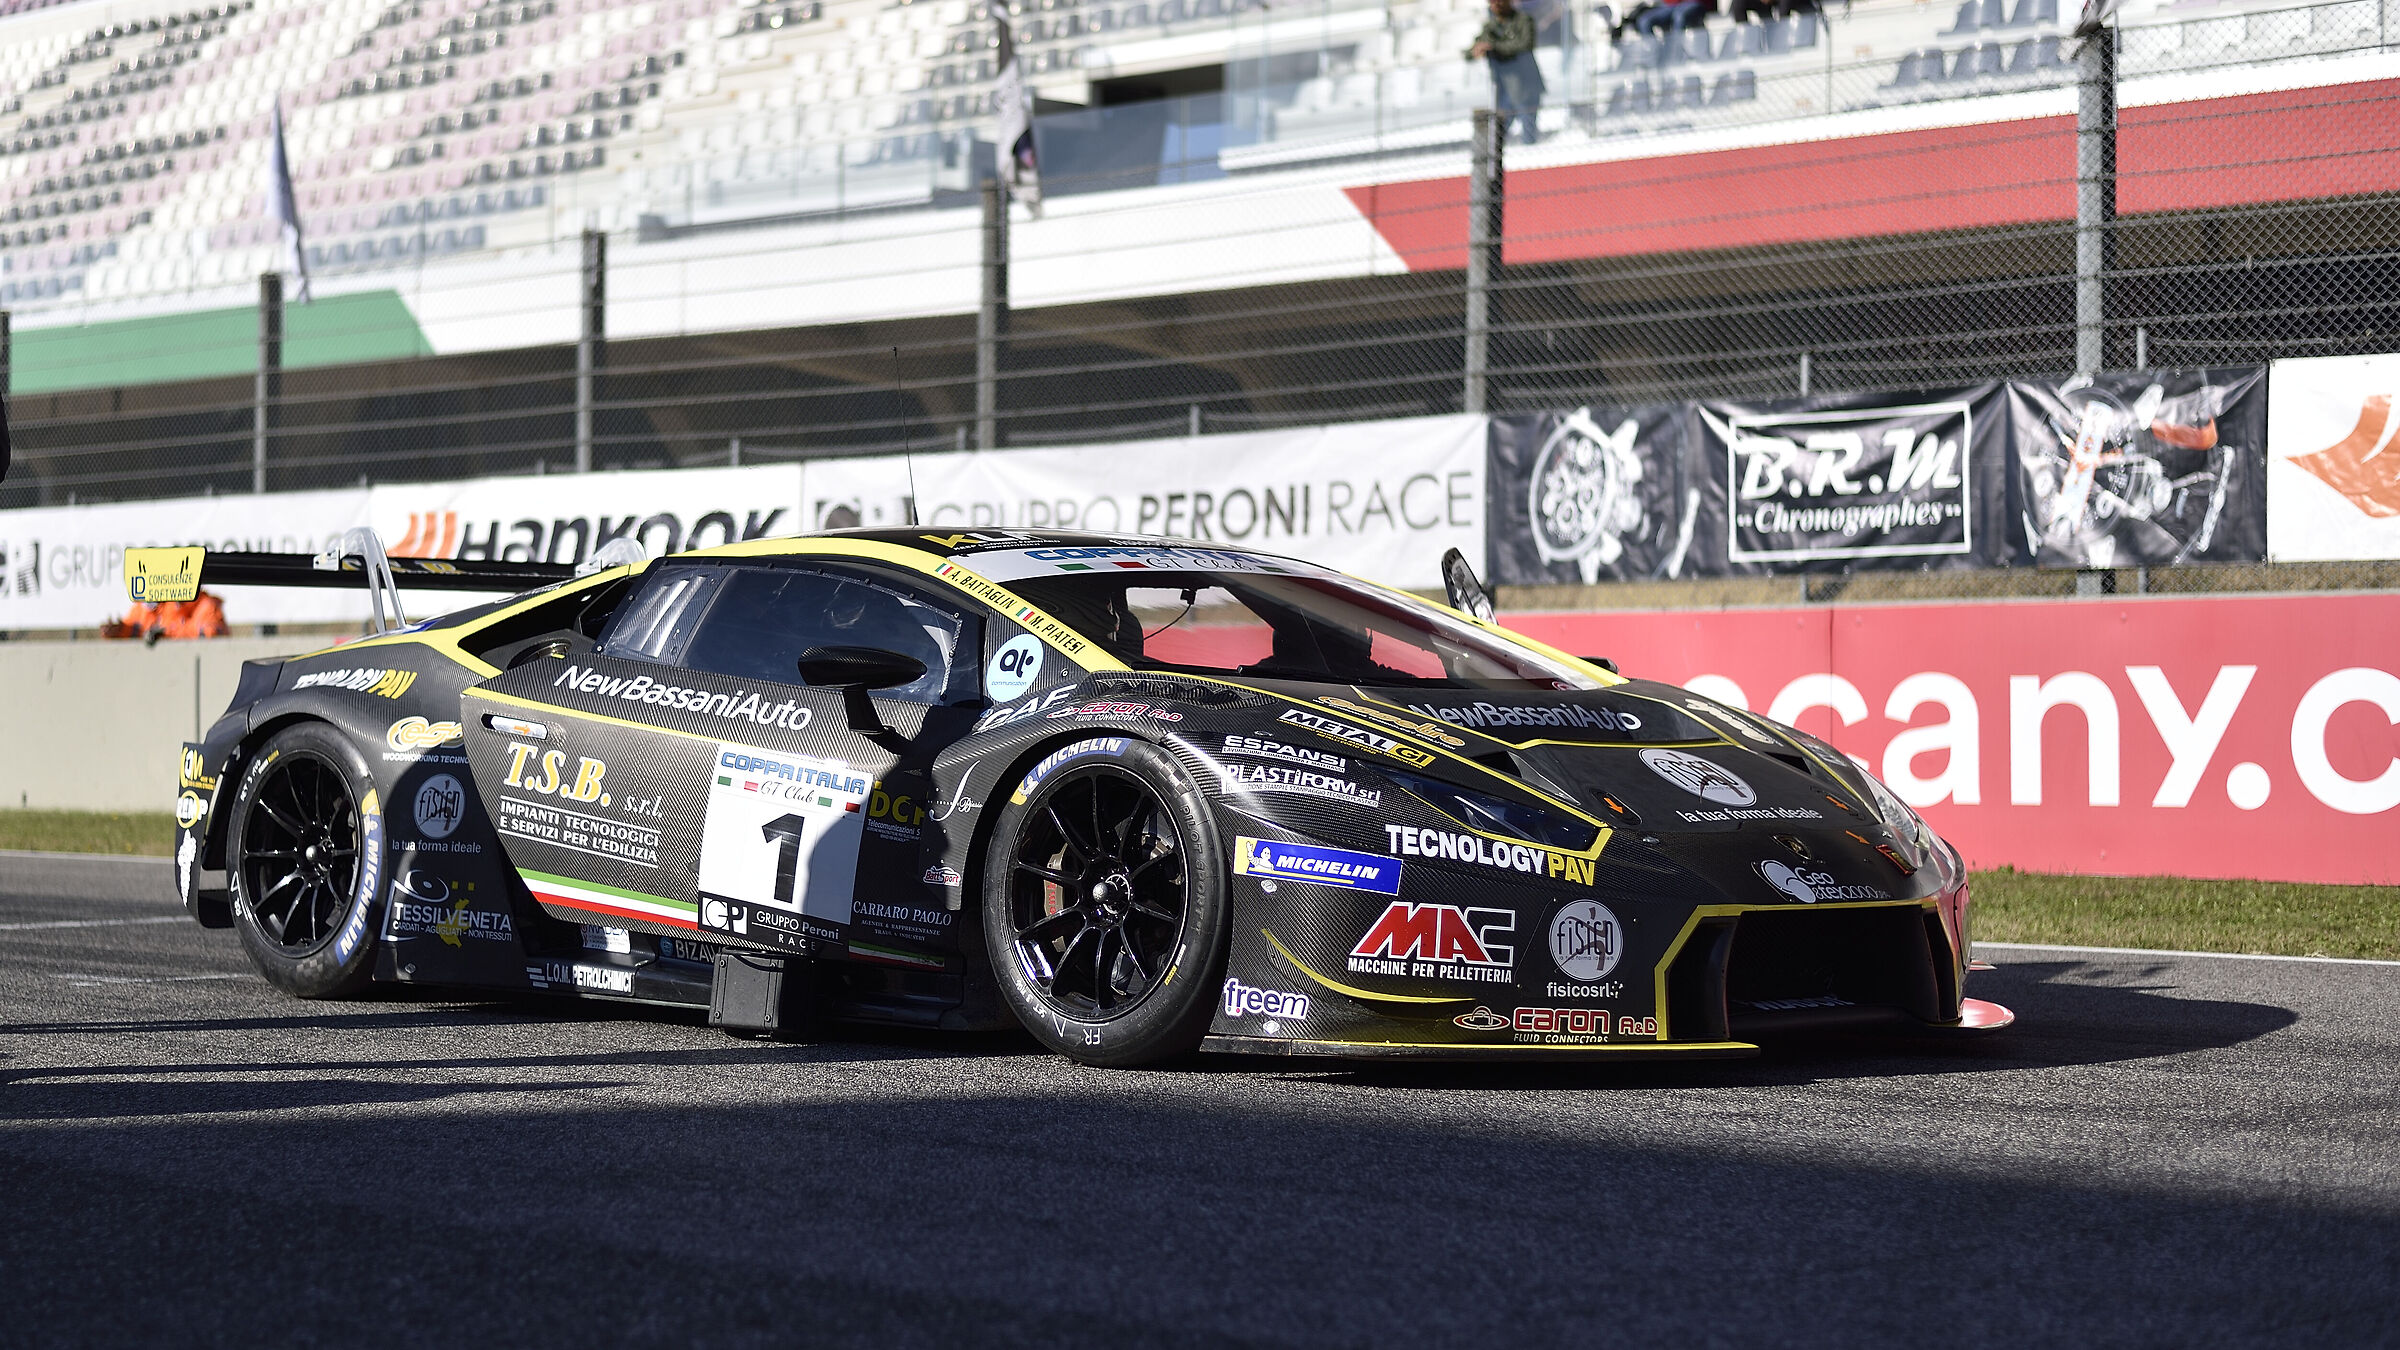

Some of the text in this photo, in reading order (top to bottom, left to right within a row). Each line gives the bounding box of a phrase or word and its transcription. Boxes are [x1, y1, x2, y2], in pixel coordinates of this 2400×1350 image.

[1138, 484, 1311, 535] PERONI
[1328, 471, 1472, 534] RACE
[148, 572, 193, 586] CONSULENZE
[148, 587, 193, 600] SOFTWARE
[948, 569, 1019, 611] A. BATTAGLIN
[1041, 623, 1087, 656] PIATESI
[554, 664, 813, 733] NewBassaniAuto
[382, 752, 439, 763] WOODWORKING
[1038, 738, 1123, 779] MICHELIN
[1225, 734, 1347, 768] ESPANSI
[504, 741, 612, 808] T.S.B.
[760, 780, 781, 797] GT
[1358, 788, 1381, 801] srl
[500, 800, 660, 847] IMPIANTI TECNOLOGICI
[1701, 810, 1727, 822] tua
[1725, 807, 1774, 821] forma
[1773, 807, 1824, 819] ideale
[392, 839, 482, 854] la tua forma ideale
[500, 815, 658, 864] E SERVIZI PER L'EDILIZIA
[761, 812, 806, 905] 1
[1276, 855, 1380, 884] MICHELIN
[1794, 866, 1835, 886] Geo
[339, 837, 380, 957] MICHELIN
[394, 901, 512, 932] TESSILVENETA
[756, 910, 840, 940] GRUPPO Peroni
[853, 901, 952, 926] CARRARO PAOLO
[393, 921, 420, 932] CARDATI
[468, 930, 484, 939] NON
[485, 931, 512, 942] TESSUTI
[1351, 900, 1516, 968] MAC
[547, 962, 571, 984] L.O.M.
[1348, 957, 1512, 984] MACCHINE PER PELLETTERIA
[1226, 981, 1308, 1018] freem
[1514, 1006, 1659, 1036] caron A&D
[1083, 1028, 1101, 1046] FR
[1513, 1032, 1540, 1043] FLUID
